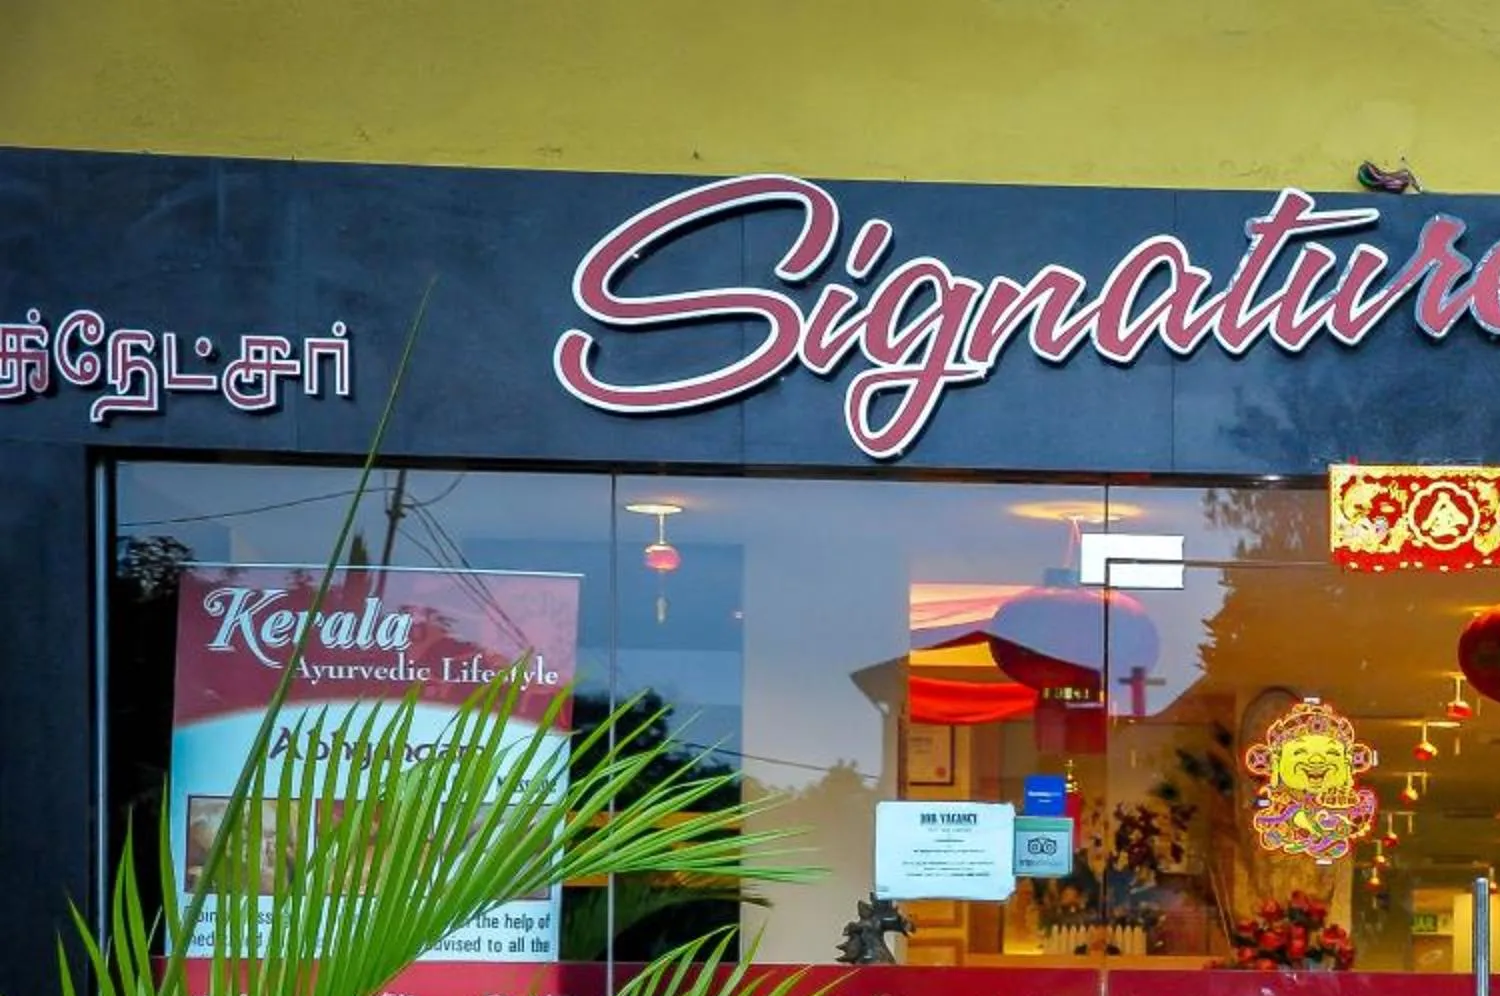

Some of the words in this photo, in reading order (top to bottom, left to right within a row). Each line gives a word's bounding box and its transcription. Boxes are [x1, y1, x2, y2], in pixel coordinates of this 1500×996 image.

[202, 587, 413, 668] Kerala
[293, 651, 431, 686] Ayurvedic
[476, 913, 499, 930] the
[504, 913, 534, 932] help
[538, 912, 551, 929] of
[487, 938, 503, 953] to
[508, 936, 526, 953] all
[530, 936, 551, 953] the
